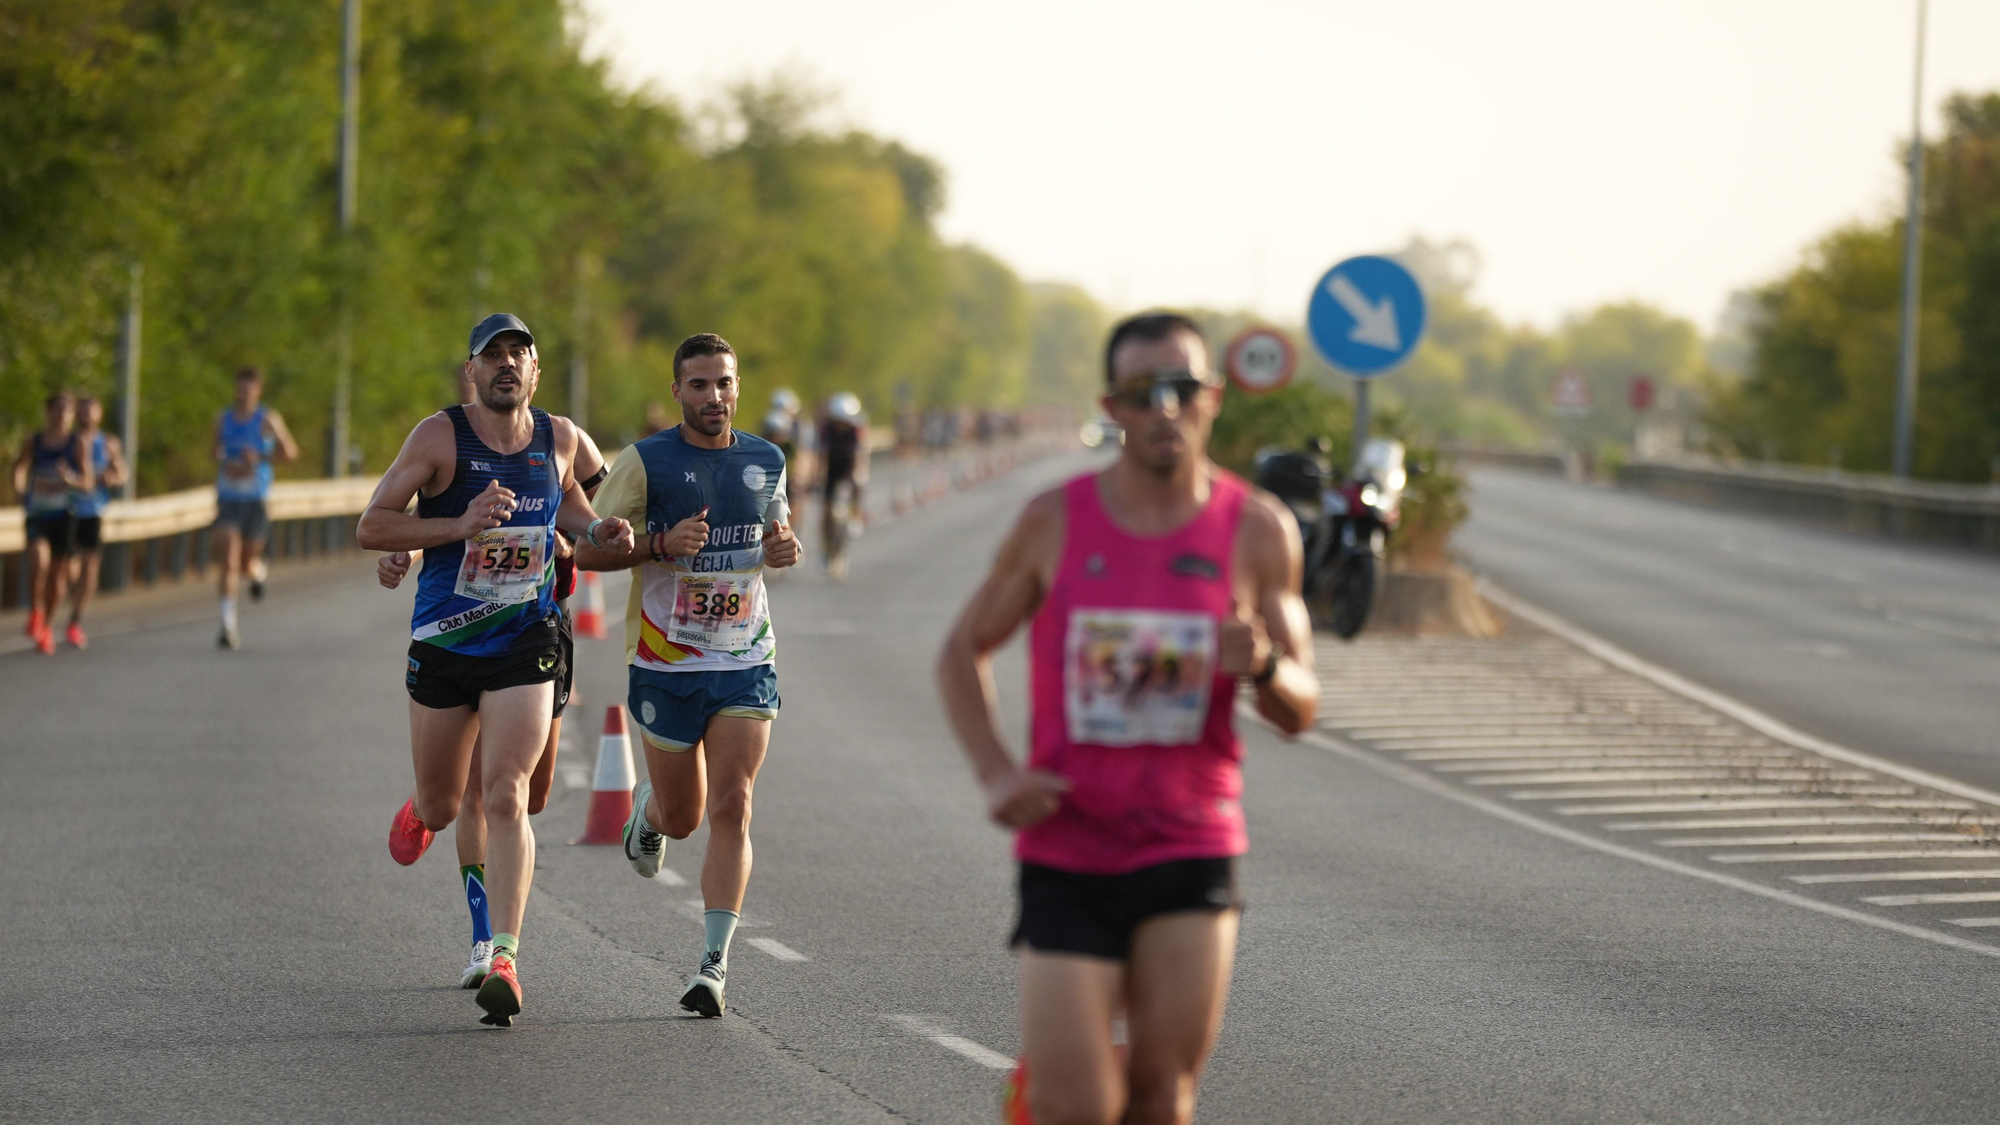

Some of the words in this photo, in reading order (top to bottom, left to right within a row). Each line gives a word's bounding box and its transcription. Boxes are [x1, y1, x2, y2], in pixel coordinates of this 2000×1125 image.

[482, 546, 530, 570] 525
[692, 592, 740, 616] 388
[437, 616, 463, 632] Club
[463, 602, 507, 624] Marato
